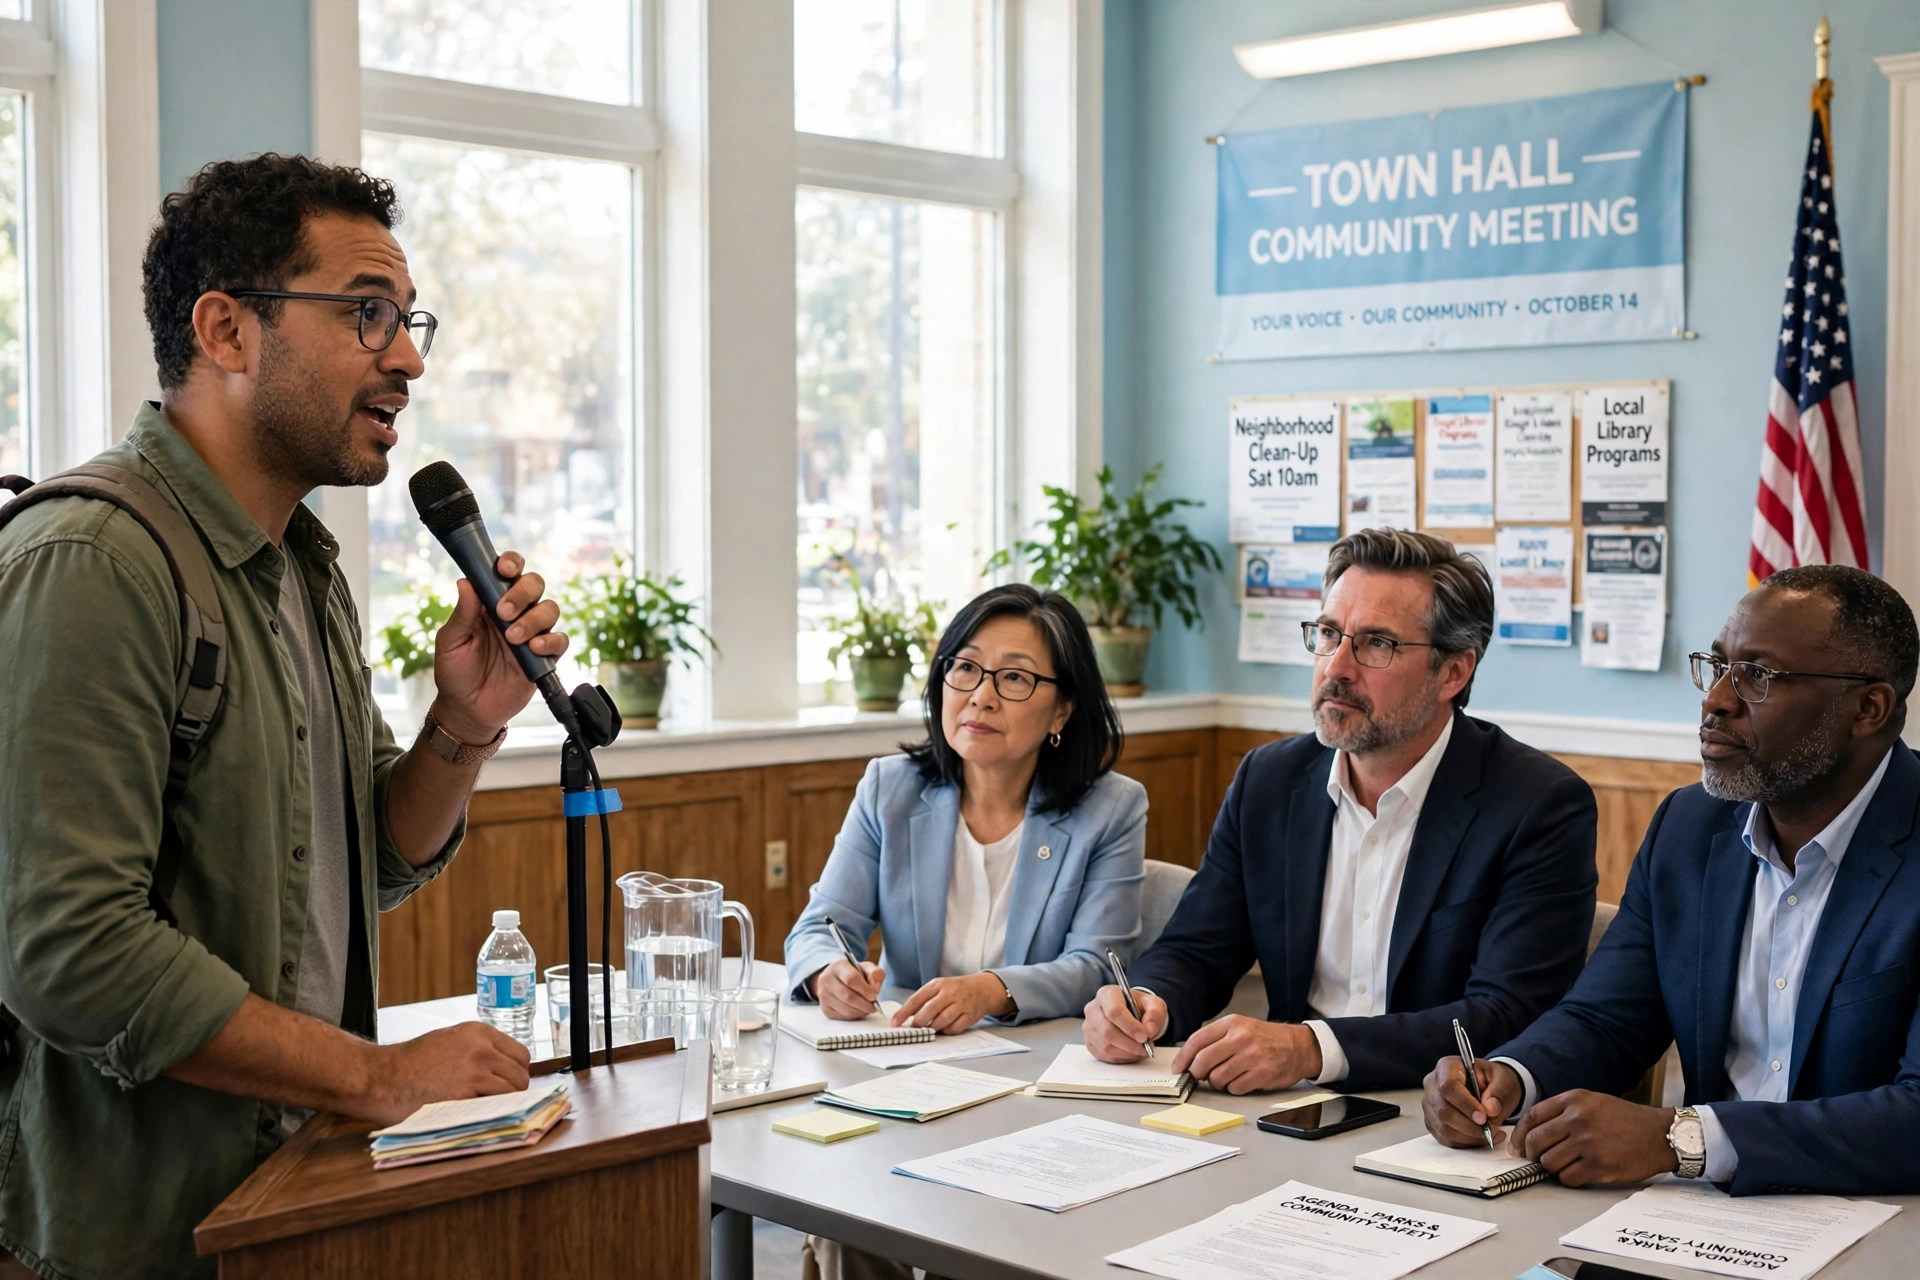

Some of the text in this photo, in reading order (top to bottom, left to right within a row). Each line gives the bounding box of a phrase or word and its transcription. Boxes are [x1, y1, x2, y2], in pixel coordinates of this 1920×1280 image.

[1303, 138, 1573, 208] TOWN HALL
[1248, 197, 1639, 264] COMMUNITY MEETING
[1251, 292, 1639, 332] YOUR VOICE OUR COMMUNITY OCTOBER 14
[1604, 396, 1644, 416] Local
[1235, 416, 1334, 440] Neighborhood
[1597, 421, 1652, 444] Library
[1249, 442, 1318, 465] Clean-Up
[1587, 445, 1661, 467] Programs
[1248, 468, 1318, 487] Sat 10am
[1280, 1201, 1441, 1240] COMMUNITY SAFETY
[1294, 1195, 1359, 1214] AGENDA
[1372, 1212, 1426, 1228] PARKS
[1681, 1240, 1788, 1263] COMMUNITY
